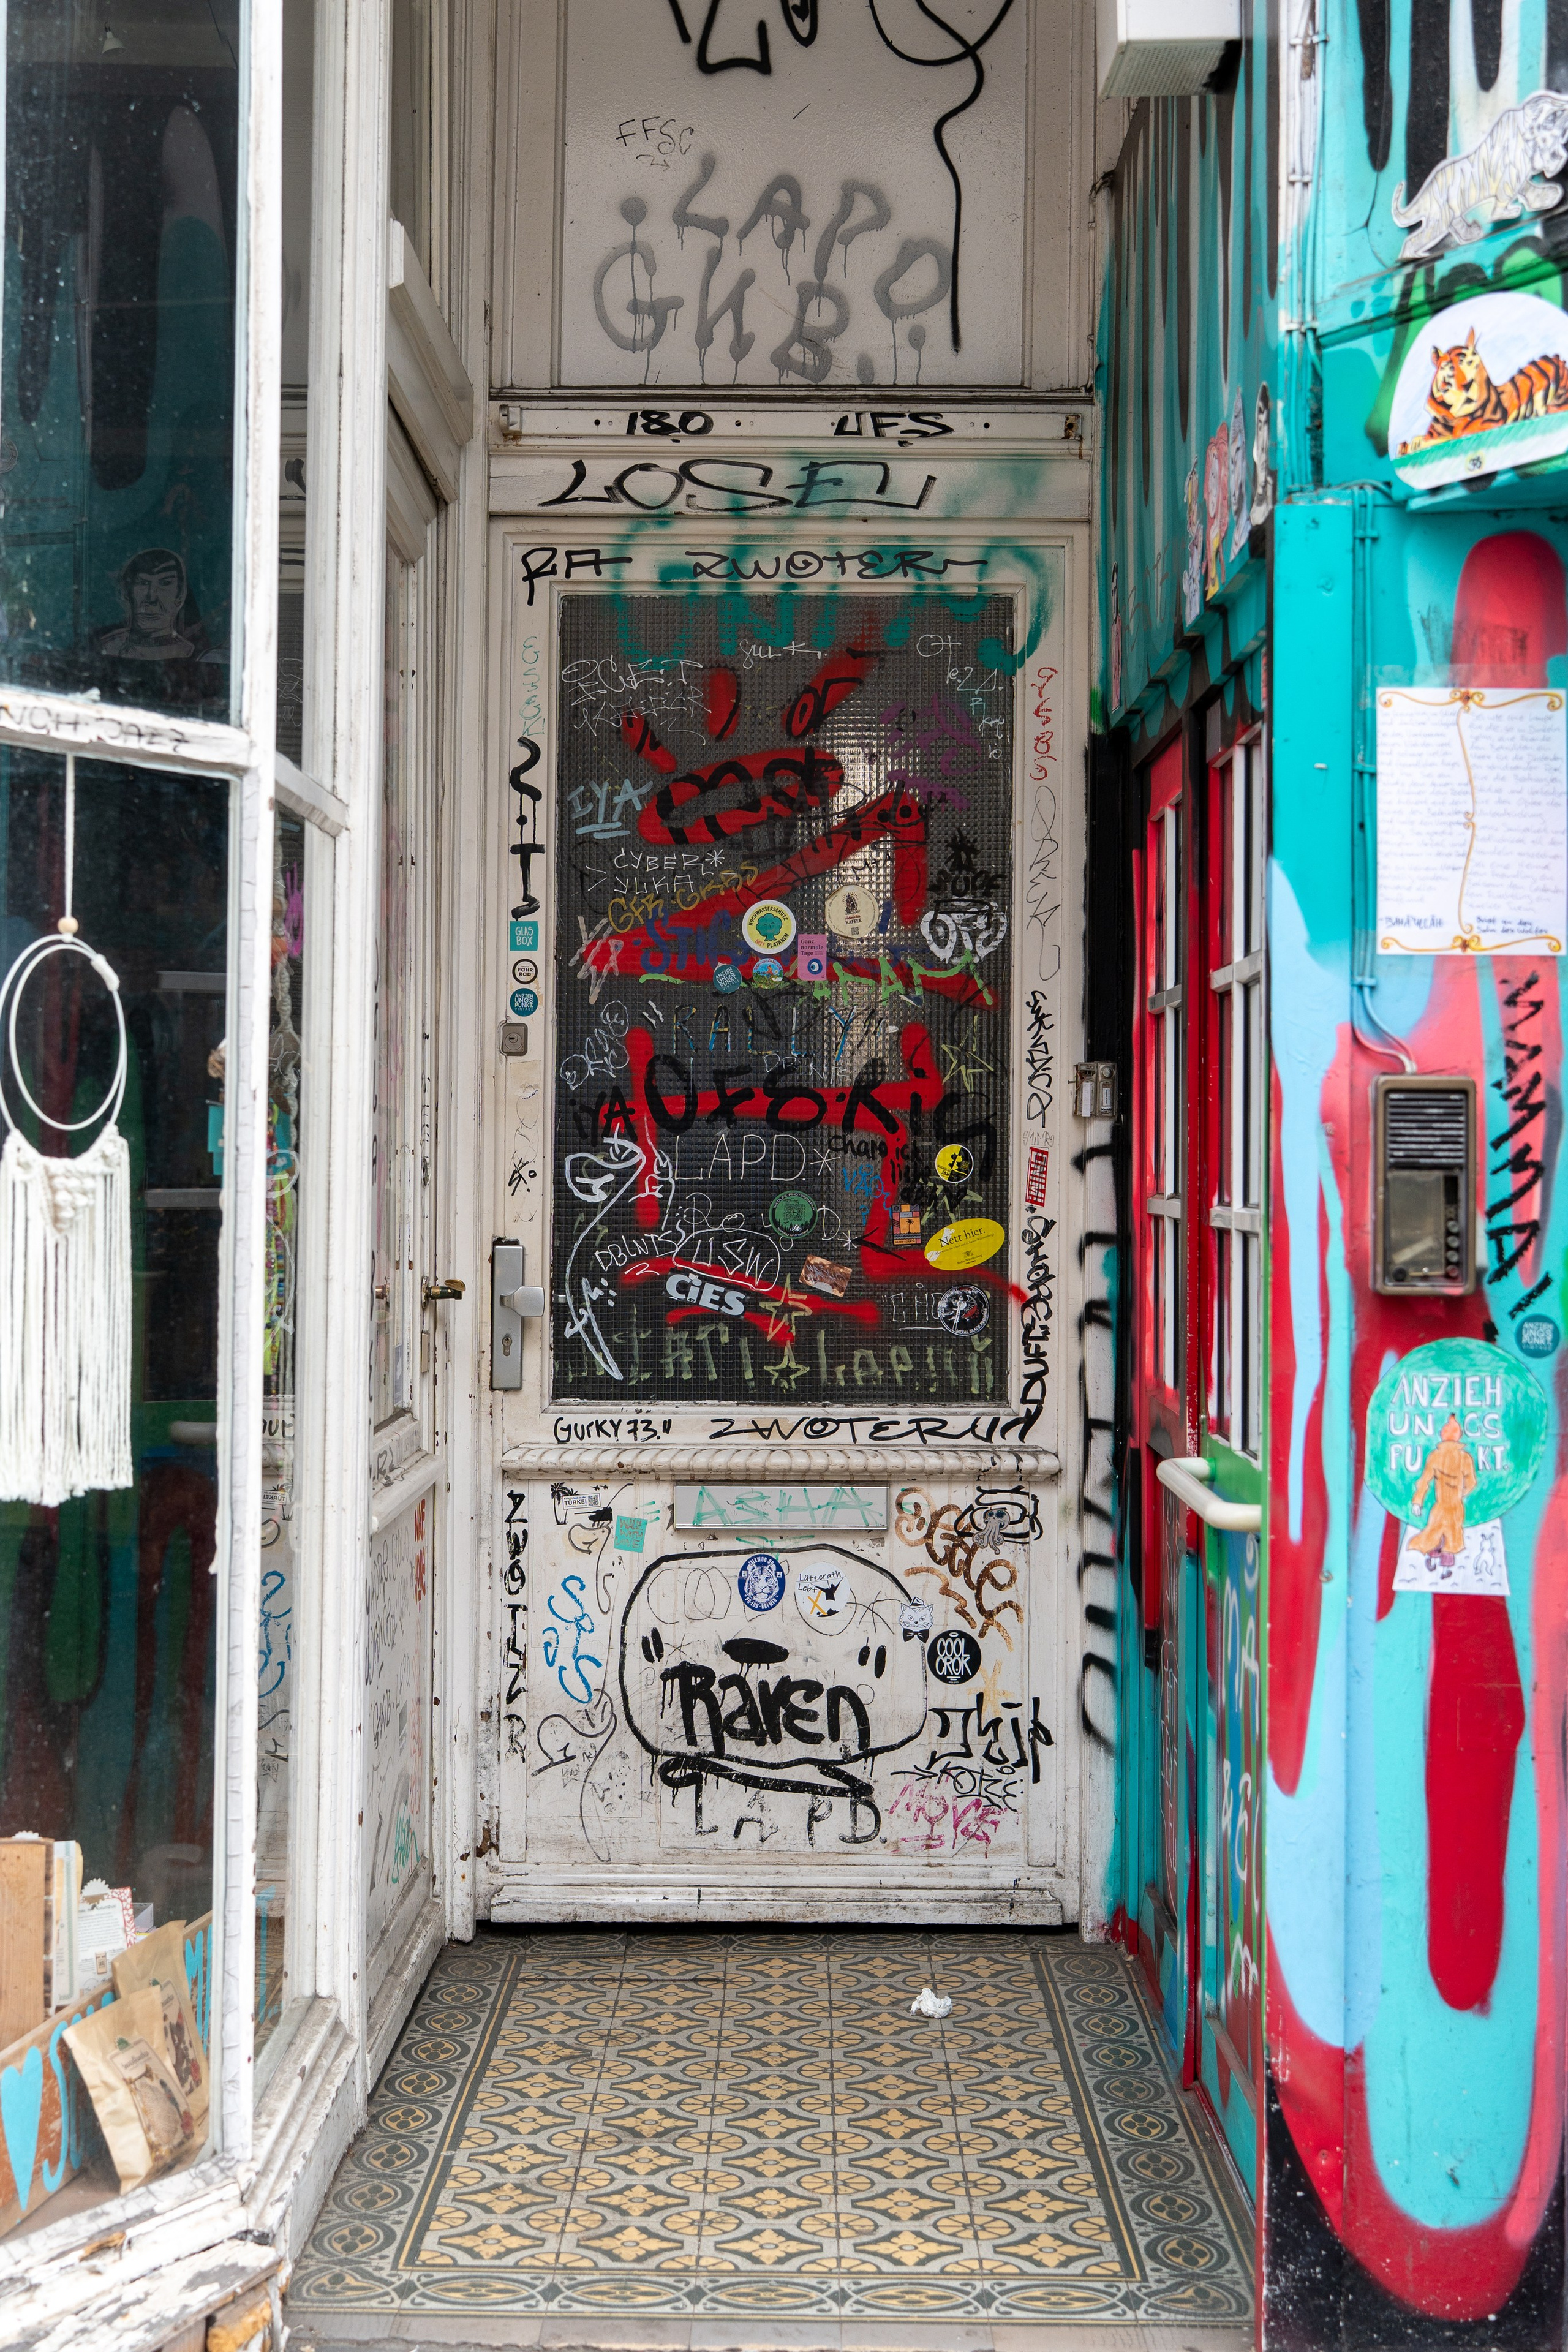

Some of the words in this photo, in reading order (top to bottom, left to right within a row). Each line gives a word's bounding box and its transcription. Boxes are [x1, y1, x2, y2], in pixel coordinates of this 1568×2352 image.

[748, 906, 789, 927] HOCHWASSERSCHUTZ
[515, 926, 533, 936] GLAS
[516, 936, 533, 947] BOX
[755, 938, 766, 948] MIT
[767, 933, 790, 948] PLATANEN
[715, 967, 733, 979] ANZIEH
[717, 970, 736, 984] UNGS
[774, 1194, 788, 1208] WILDLIFE
[788, 1193, 816, 1211] PHOTOGRAPHY
[938, 1234, 963, 1248] Nett
[963, 1227, 986, 1239] hier.
[969, 1325, 981, 1333] BLADE
[1391, 1373, 1502, 1408] ANZIEH
[799, 1570, 842, 1582] Lützerath
[937, 1637, 970, 1657] COOL
[935, 1656, 972, 1676] CROK
